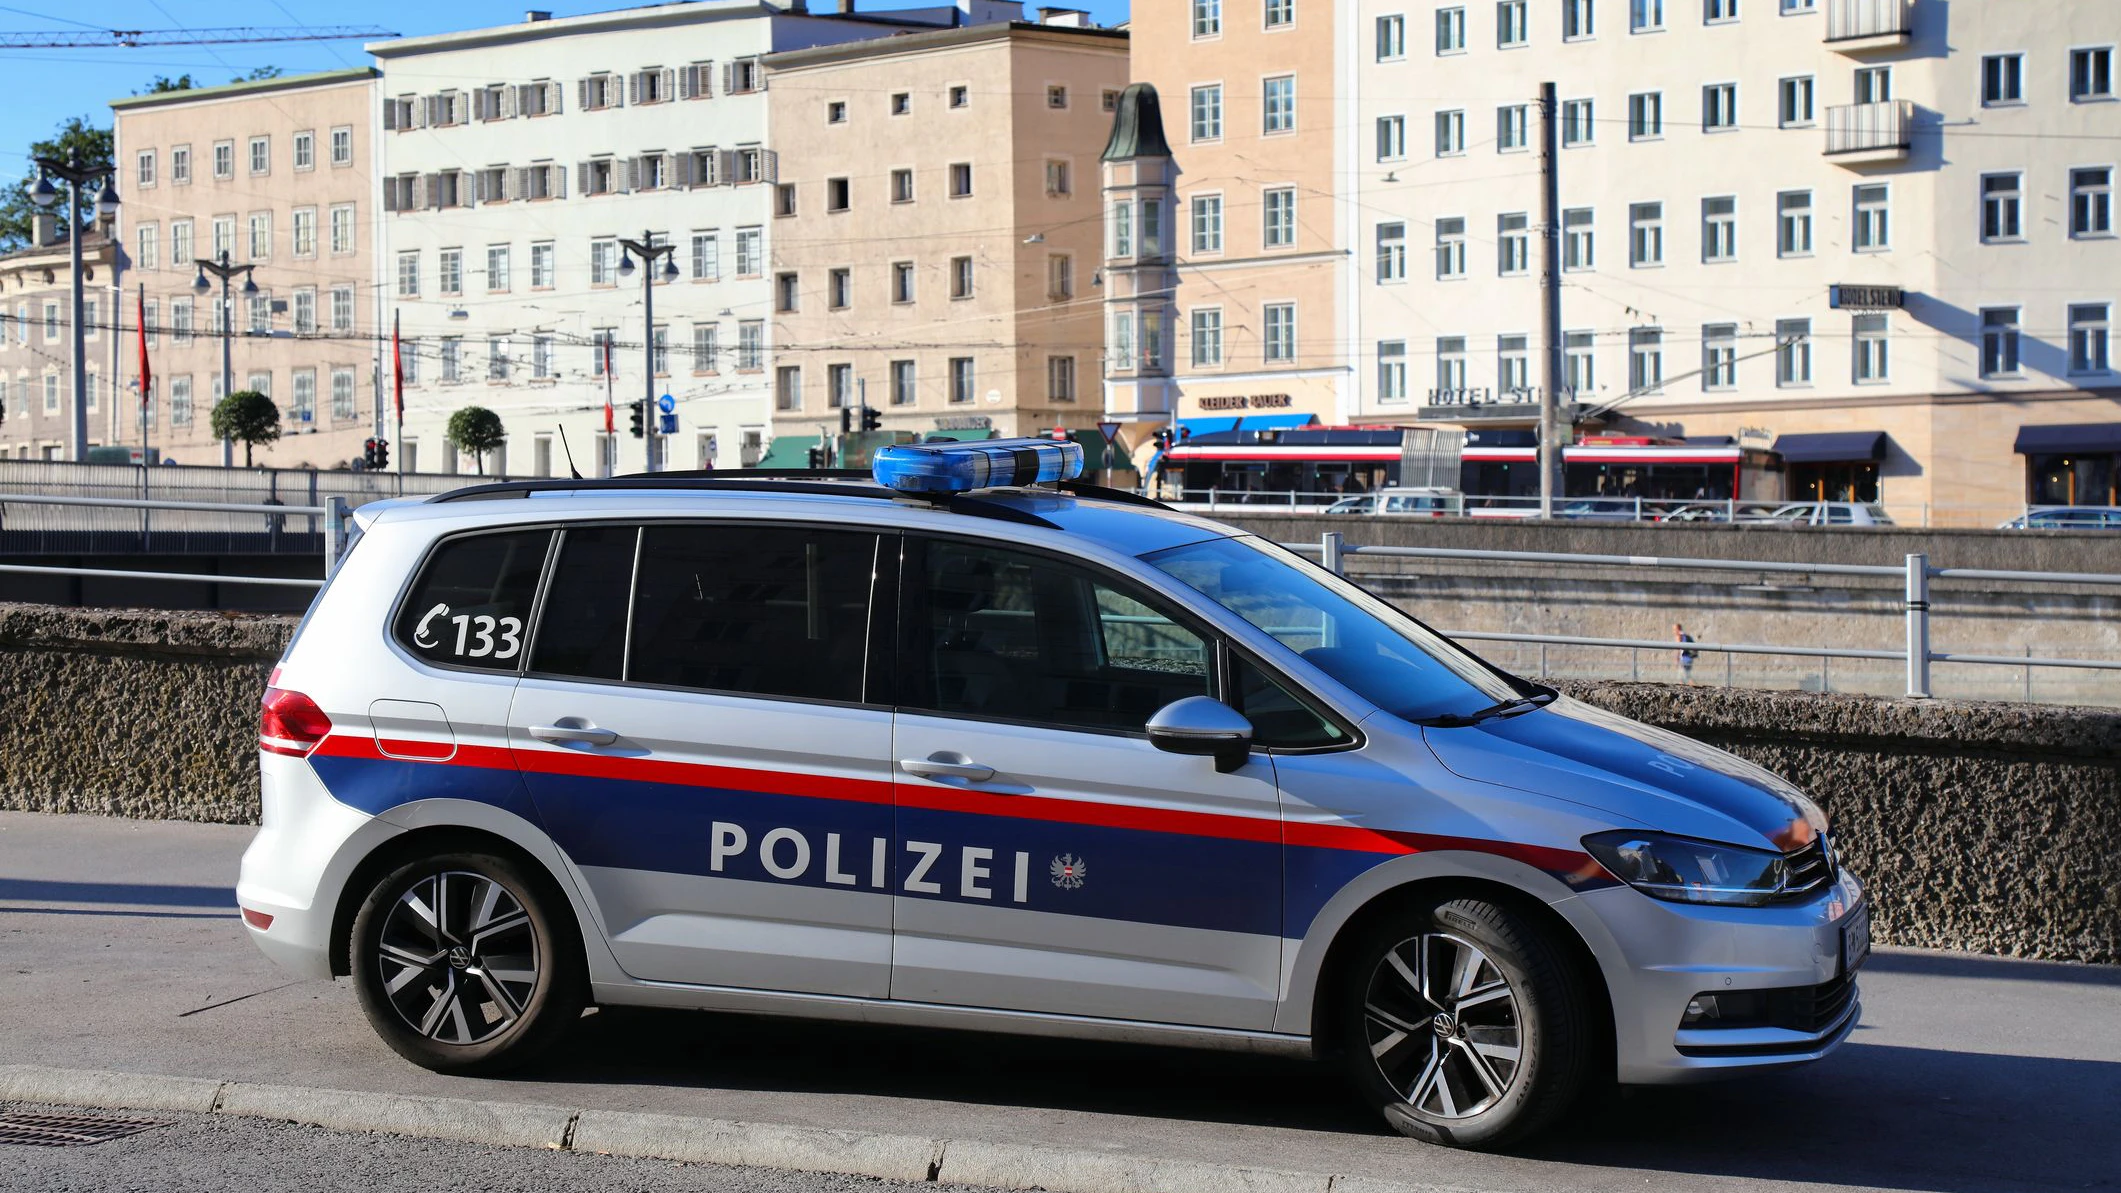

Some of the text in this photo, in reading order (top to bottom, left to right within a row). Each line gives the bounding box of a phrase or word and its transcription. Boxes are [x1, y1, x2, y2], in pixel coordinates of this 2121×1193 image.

[1199, 396, 1248, 410] KLEIDER
[1429, 385, 1576, 405] HOTEL STN
[452, 615, 522, 659] 133
[710, 821, 1030, 903] POLIZEI
